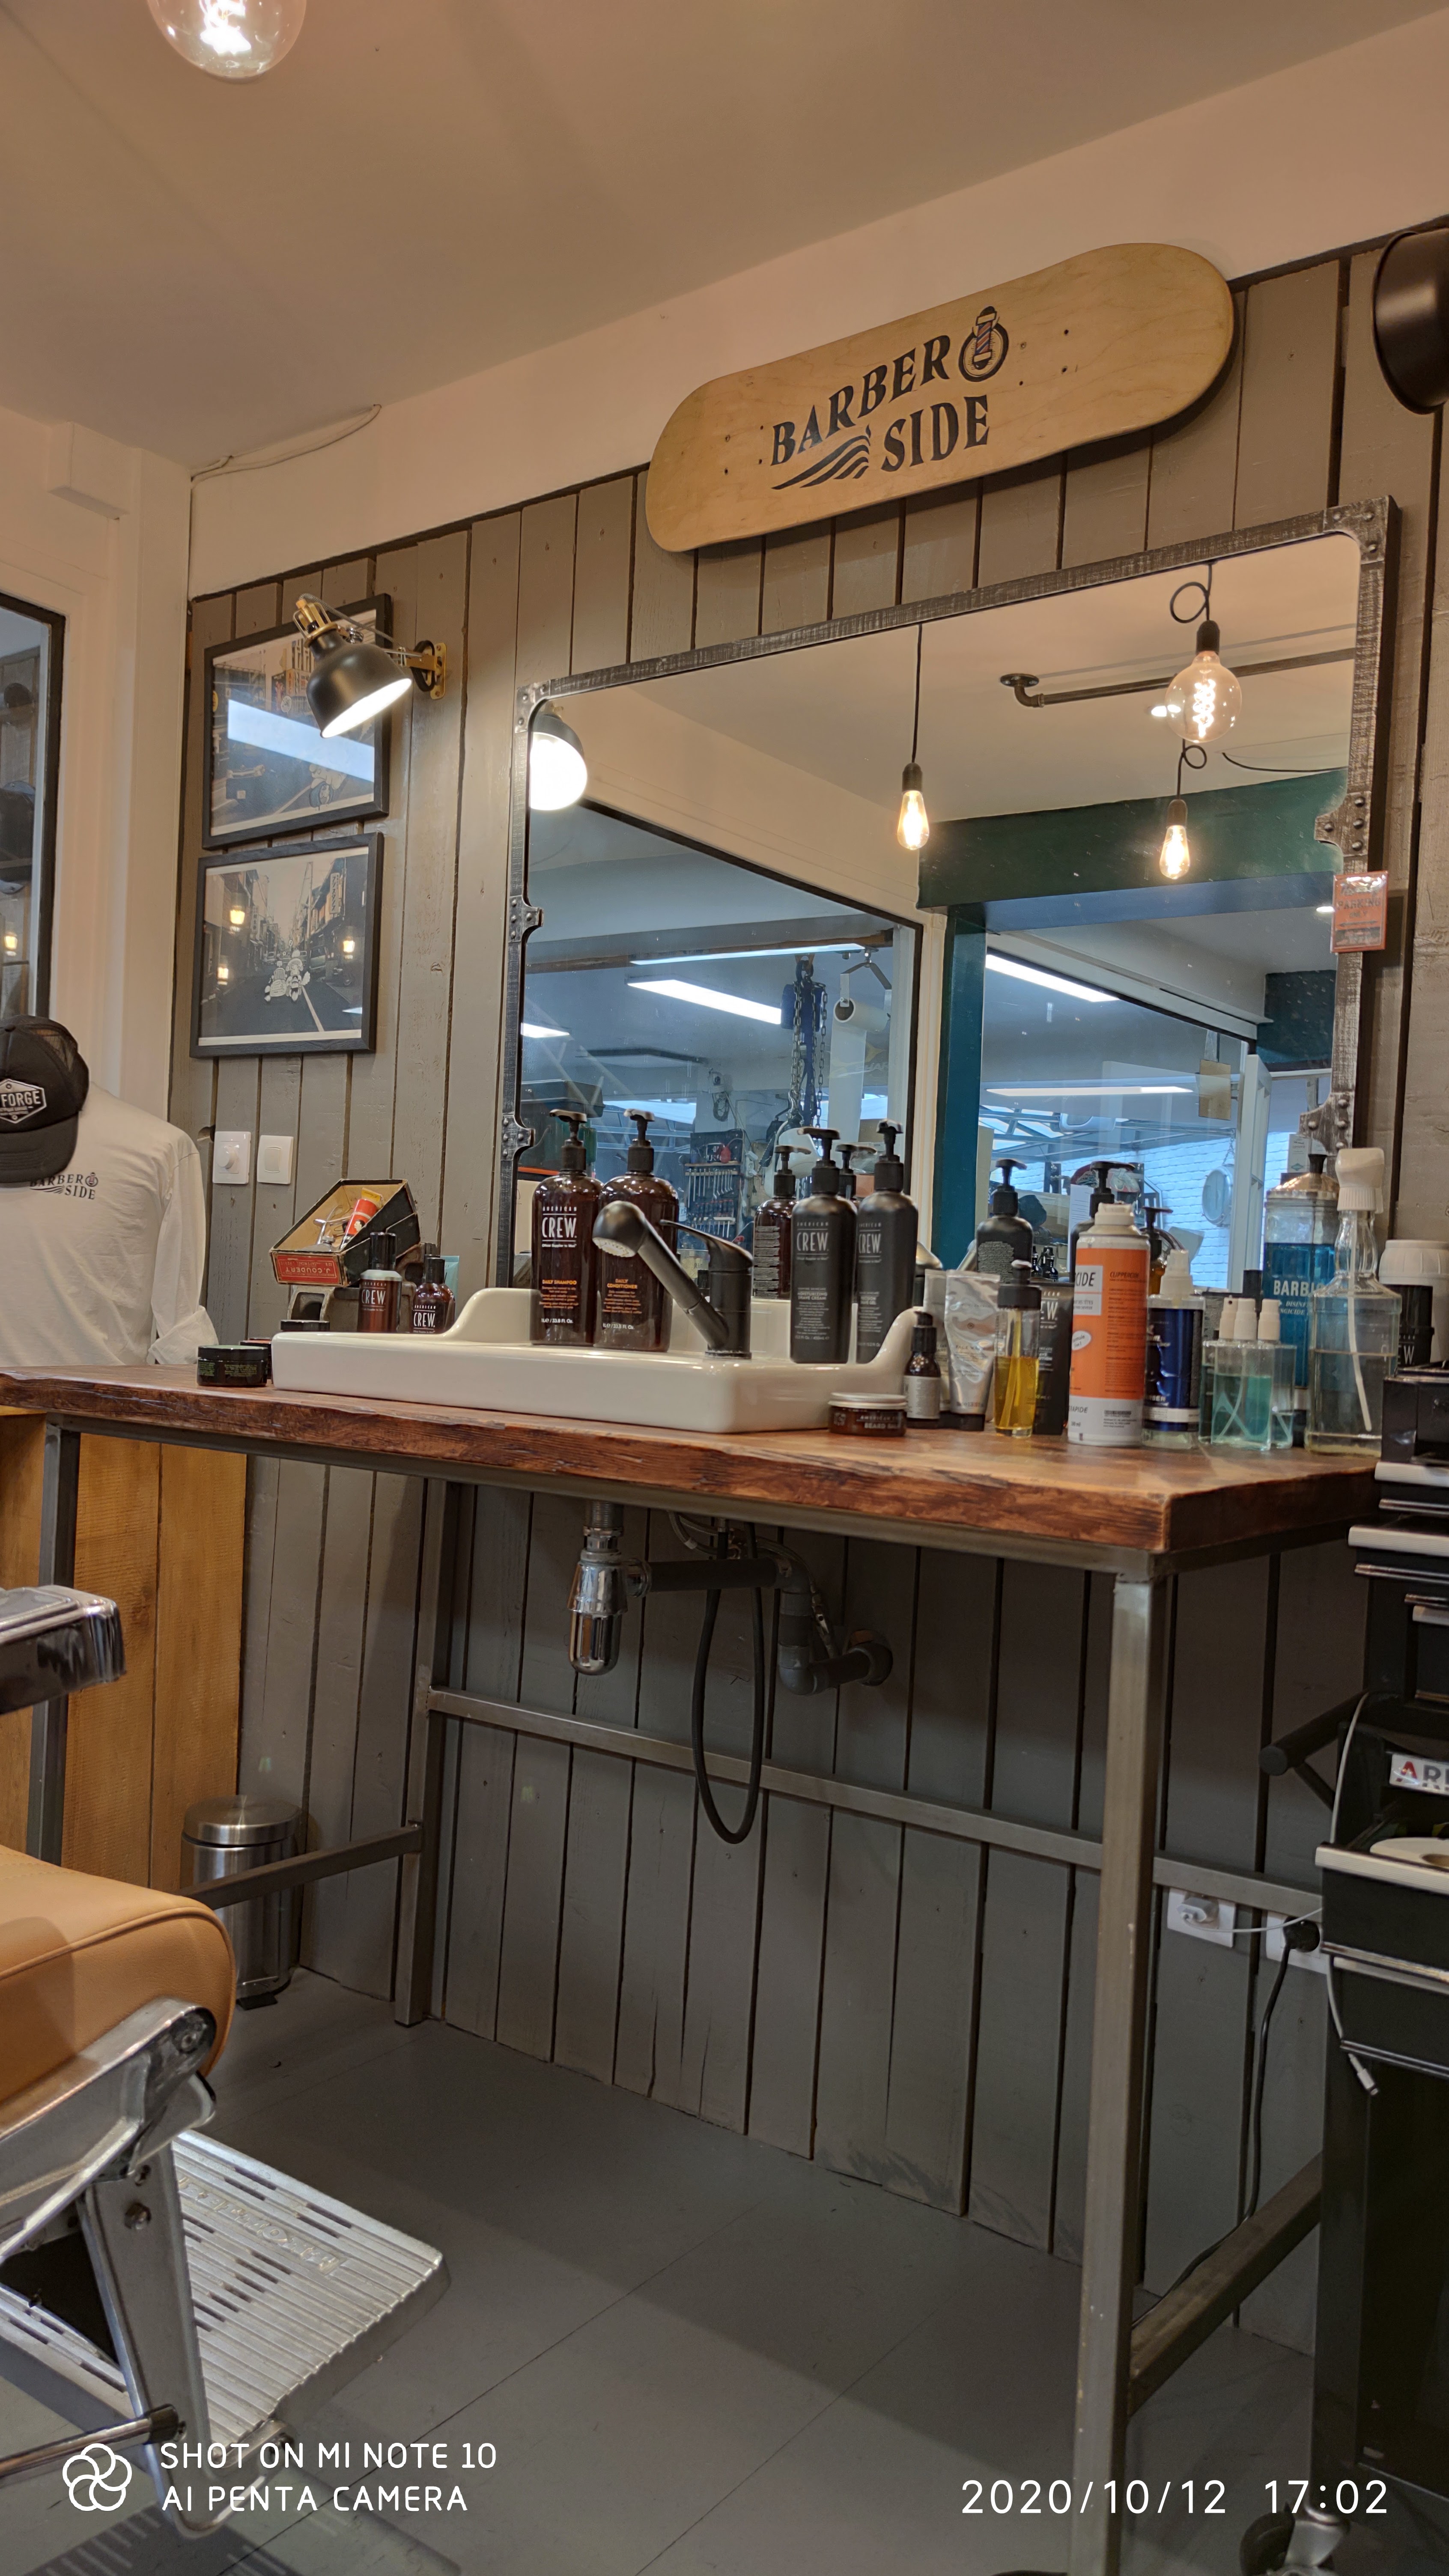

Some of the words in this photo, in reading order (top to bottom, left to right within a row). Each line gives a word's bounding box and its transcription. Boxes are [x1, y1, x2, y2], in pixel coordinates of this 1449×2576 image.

[770, 335, 951, 466] BARBER
[881, 395, 990, 472] SIDE
[1, 1091, 41, 1108] FORGE
[65, 1185, 96, 1200] SIDE
[1273, 1280, 1324, 1297] BARBI
[1396, 1761, 1449, 1791] AR
